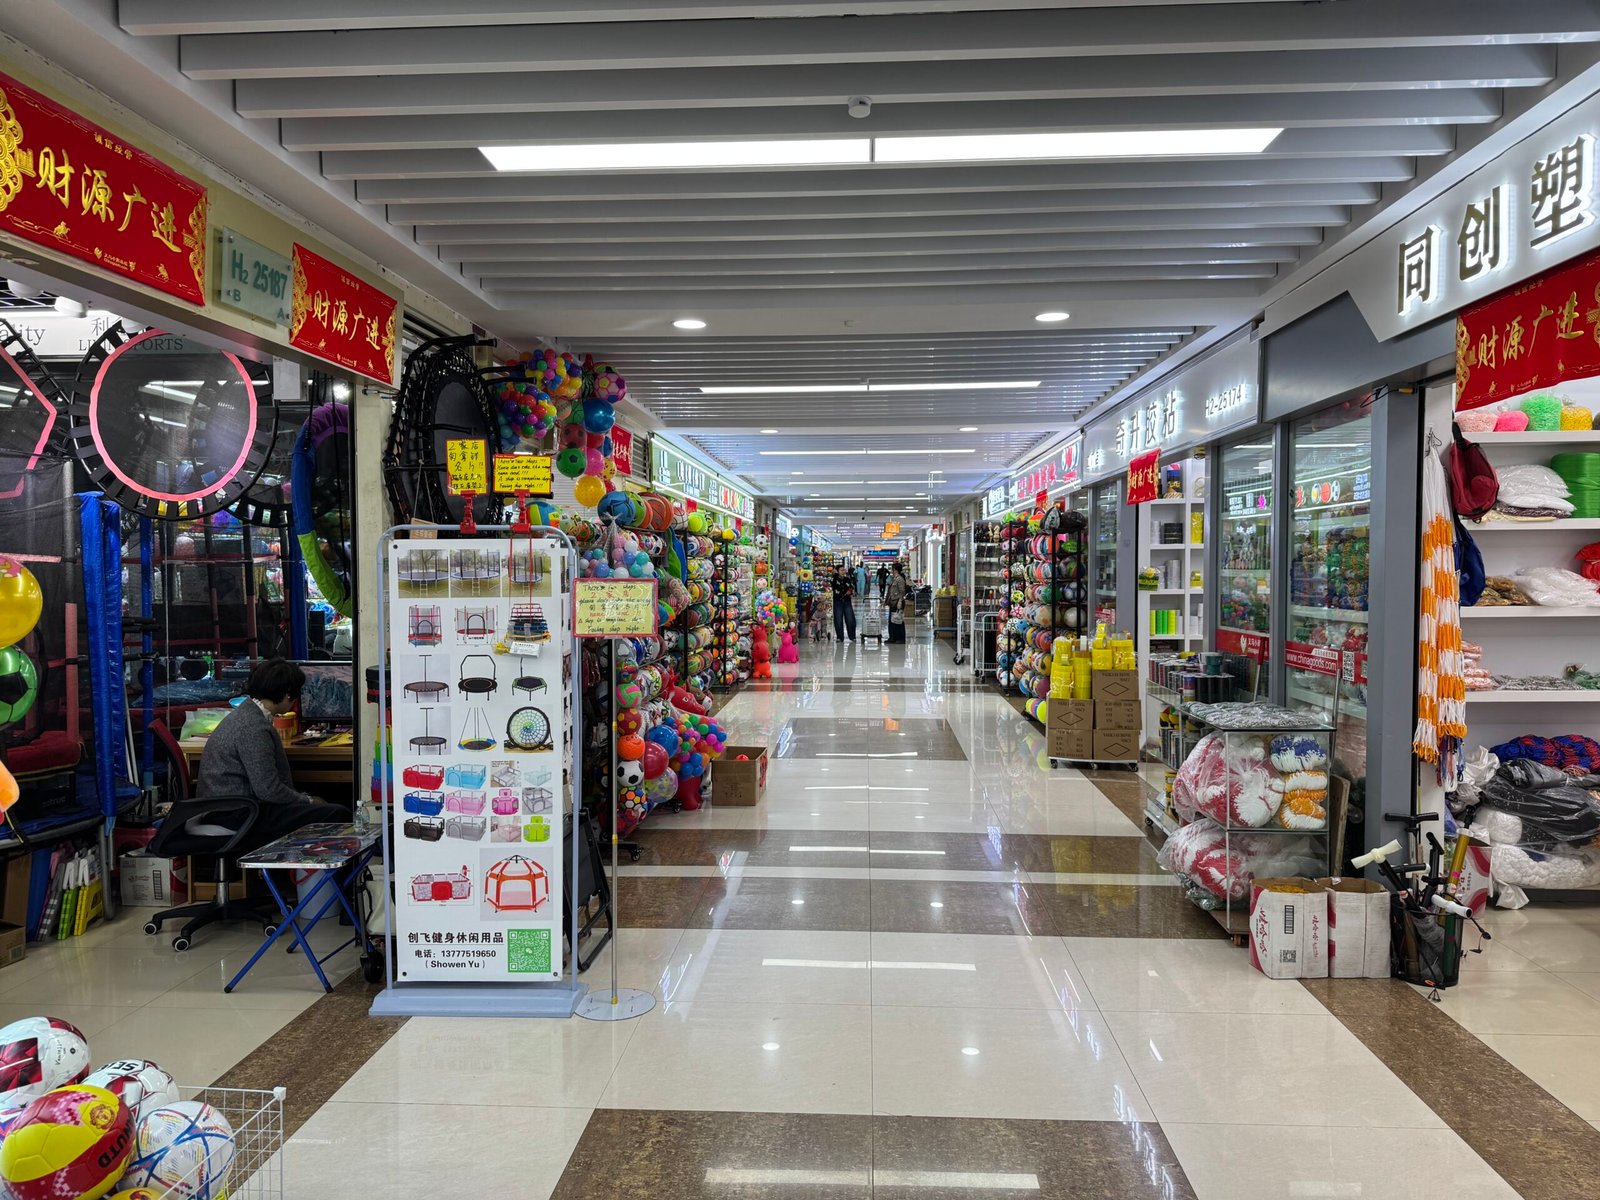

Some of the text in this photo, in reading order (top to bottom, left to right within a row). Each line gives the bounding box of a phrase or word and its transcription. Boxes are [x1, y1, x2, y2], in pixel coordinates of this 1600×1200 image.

[35, 146, 183, 254] 财源广进
[1398, 135, 1591, 316] 同创塑
[233, 289, 241, 301] B
[252, 261, 288, 300] 25187
[277, 307, 285, 320] A
[312, 290, 381, 351] 财源广进
[1478, 291, 1585, 369] 财源广进
[1204, 385, 1243, 418] H2-25174
[1115, 391, 1178, 457] 奇升胶粘
[1286, 653, 1337, 671] www.chinagoods.com
[408, 932, 504, 944] 创飞健身休闲用品
[441, 950, 496, 958] 13777519650
